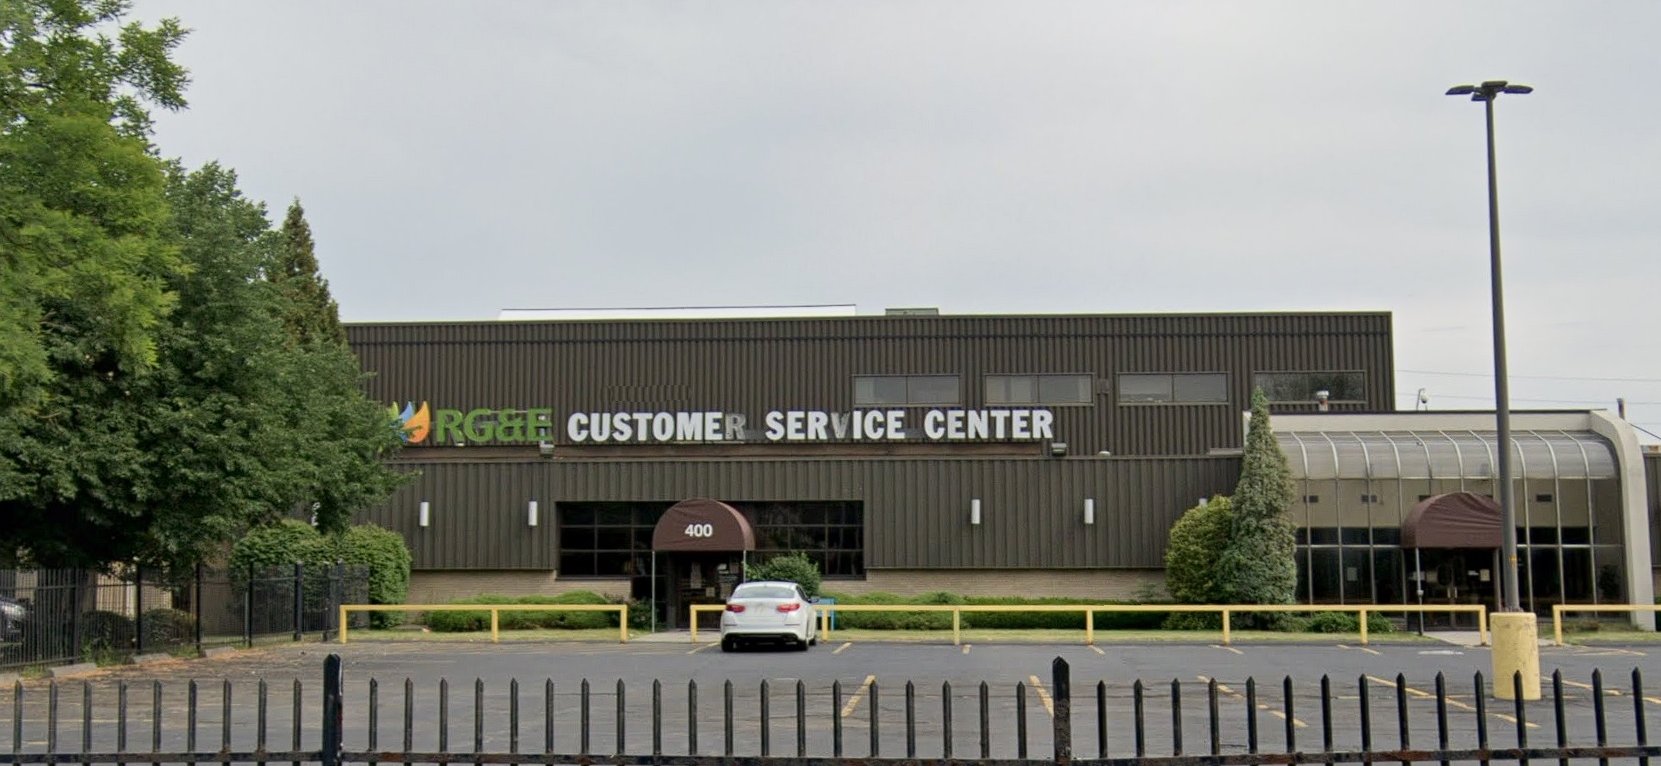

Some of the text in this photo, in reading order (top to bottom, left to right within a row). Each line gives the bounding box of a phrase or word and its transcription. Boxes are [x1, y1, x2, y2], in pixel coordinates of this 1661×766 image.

[436, 409, 1053, 442] RG&E CUSTOMER SERVICE CENTER
[684, 523, 714, 537] 400
